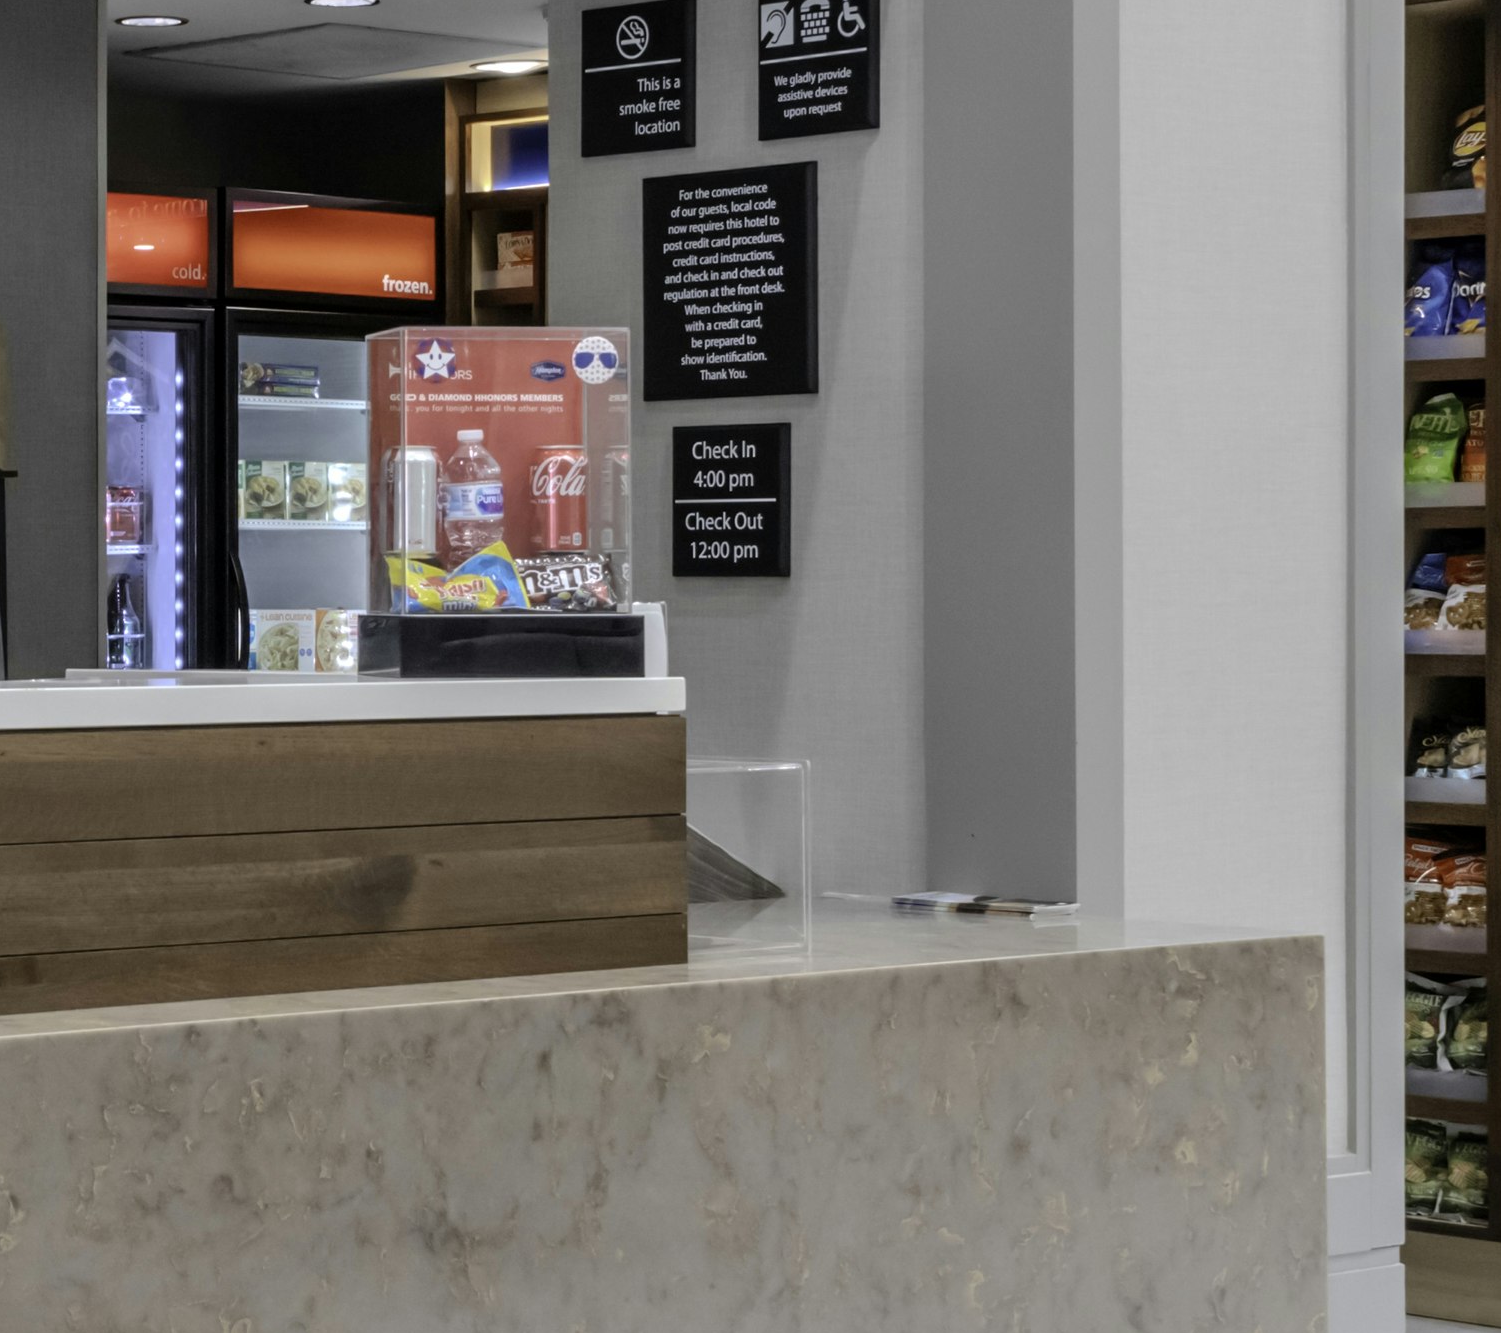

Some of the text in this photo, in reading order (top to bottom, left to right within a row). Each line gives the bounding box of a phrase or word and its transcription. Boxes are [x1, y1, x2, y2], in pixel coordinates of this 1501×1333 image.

[637, 76, 681, 92] This is a
[774, 67, 852, 89] We gladly provide
[777, 84, 848, 103] assistive devices
[619, 98, 681, 116] smoke free
[783, 101, 842, 119] upon request
[635, 120, 680, 135] location
[679, 184, 768, 201] For the convenience
[671, 198, 776, 218] of our guests, local code
[668, 216, 779, 235] now requires this hotel to
[663, 232, 784, 254] post credit card procedures,
[672, 250, 775, 268] credit card instructions,
[172, 264, 205, 280] cold.
[665, 266, 783, 284] and check in and check out
[382, 274, 432, 294] frozen.
[664, 281, 785, 303] regulation at the front desk.
[684, 300, 763, 315] When checking in
[685, 317, 763, 332] with a credit card,
[691, 335, 756, 350] be prepared to
[681, 351, 767, 365] show identification.
[700, 368, 748, 380] Thank You.
[431, 404, 444, 412] for
[446, 404, 472, 414] tonight
[475, 404, 488, 412] and
[490, 404, 501, 412] all
[503, 404, 516, 412] the
[518, 404, 538, 412] other
[540, 404, 563, 414] nights
[692, 440, 756, 459] Check In
[531, 455, 587, 496] Cola
[693, 470, 754, 492] 4:00 pm
[685, 512, 763, 530] Check Out
[690, 541, 759, 563] 12:00 pm
